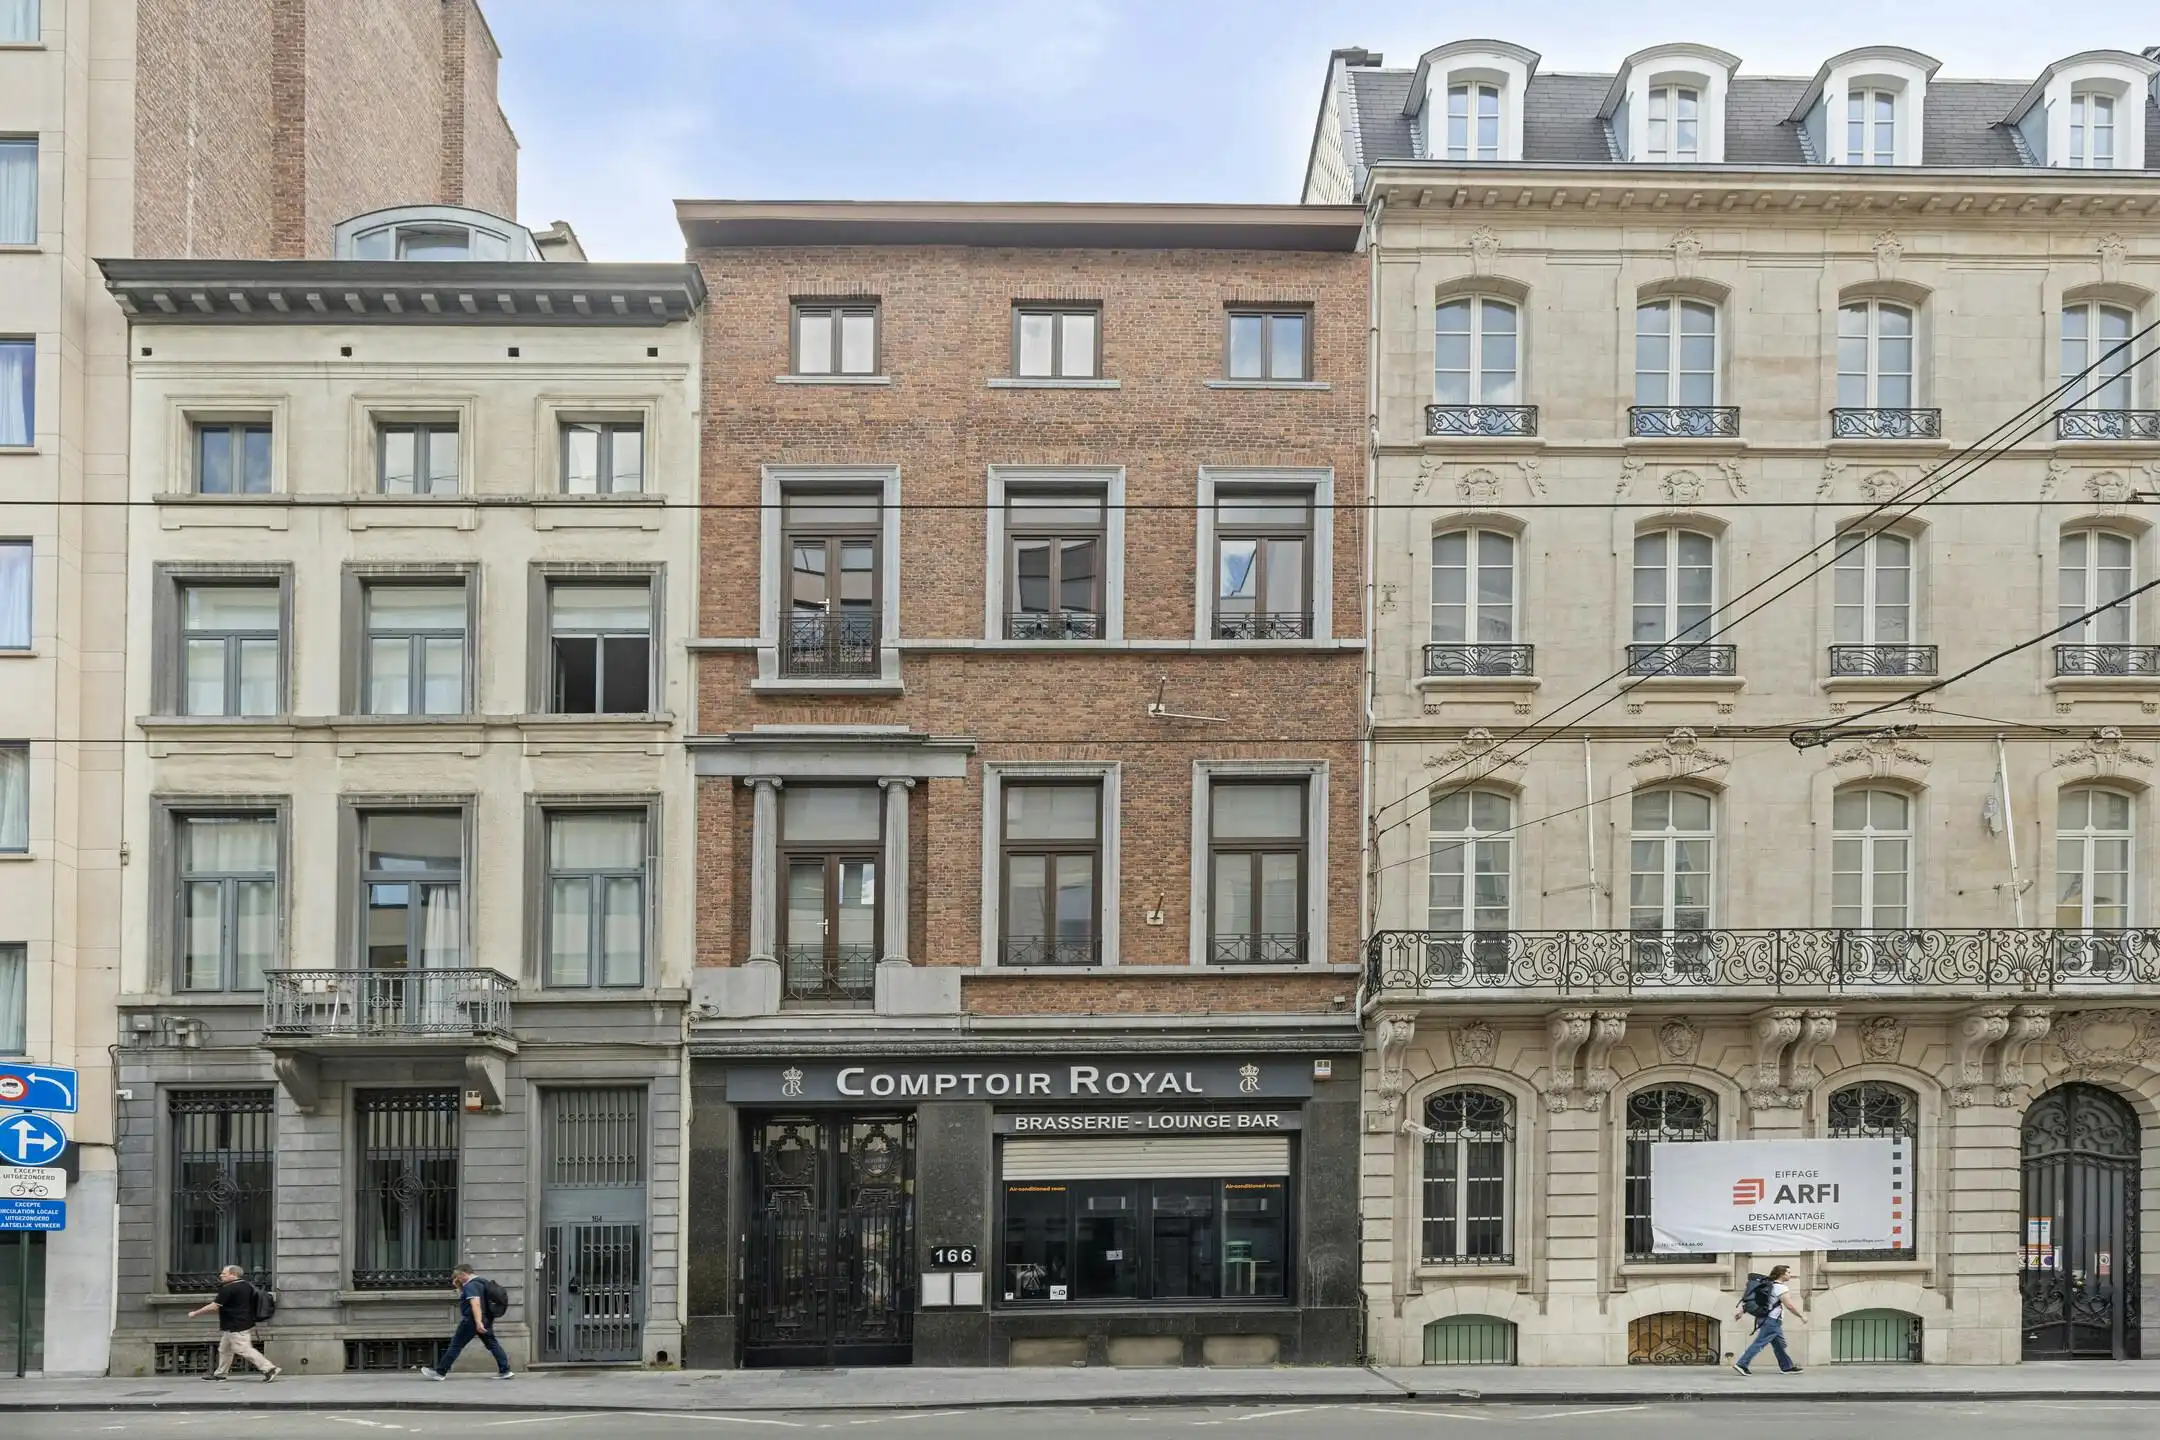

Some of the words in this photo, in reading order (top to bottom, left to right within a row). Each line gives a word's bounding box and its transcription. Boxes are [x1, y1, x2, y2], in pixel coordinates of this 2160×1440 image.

[836, 1067, 1051, 1098] COMPTOIR
[1069, 1065, 1203, 1095] ROYAL
[1015, 1115, 1129, 1131] BRASSERIE
[1148, 1114, 1231, 1130] LOUNGE
[1237, 1113, 1280, 1128] BAR
[3, 1173, 56, 1181] UITGEZONDERD
[1775, 1170, 1819, 1179] EIFFAGE
[1773, 1183, 1840, 1205] ARFI
[1748, 1212, 1826, 1222] DESAMIANTAGE
[1731, 1222, 1840, 1232] ASBESTVERWIJDERING
[935, 1248, 973, 1264] 166
